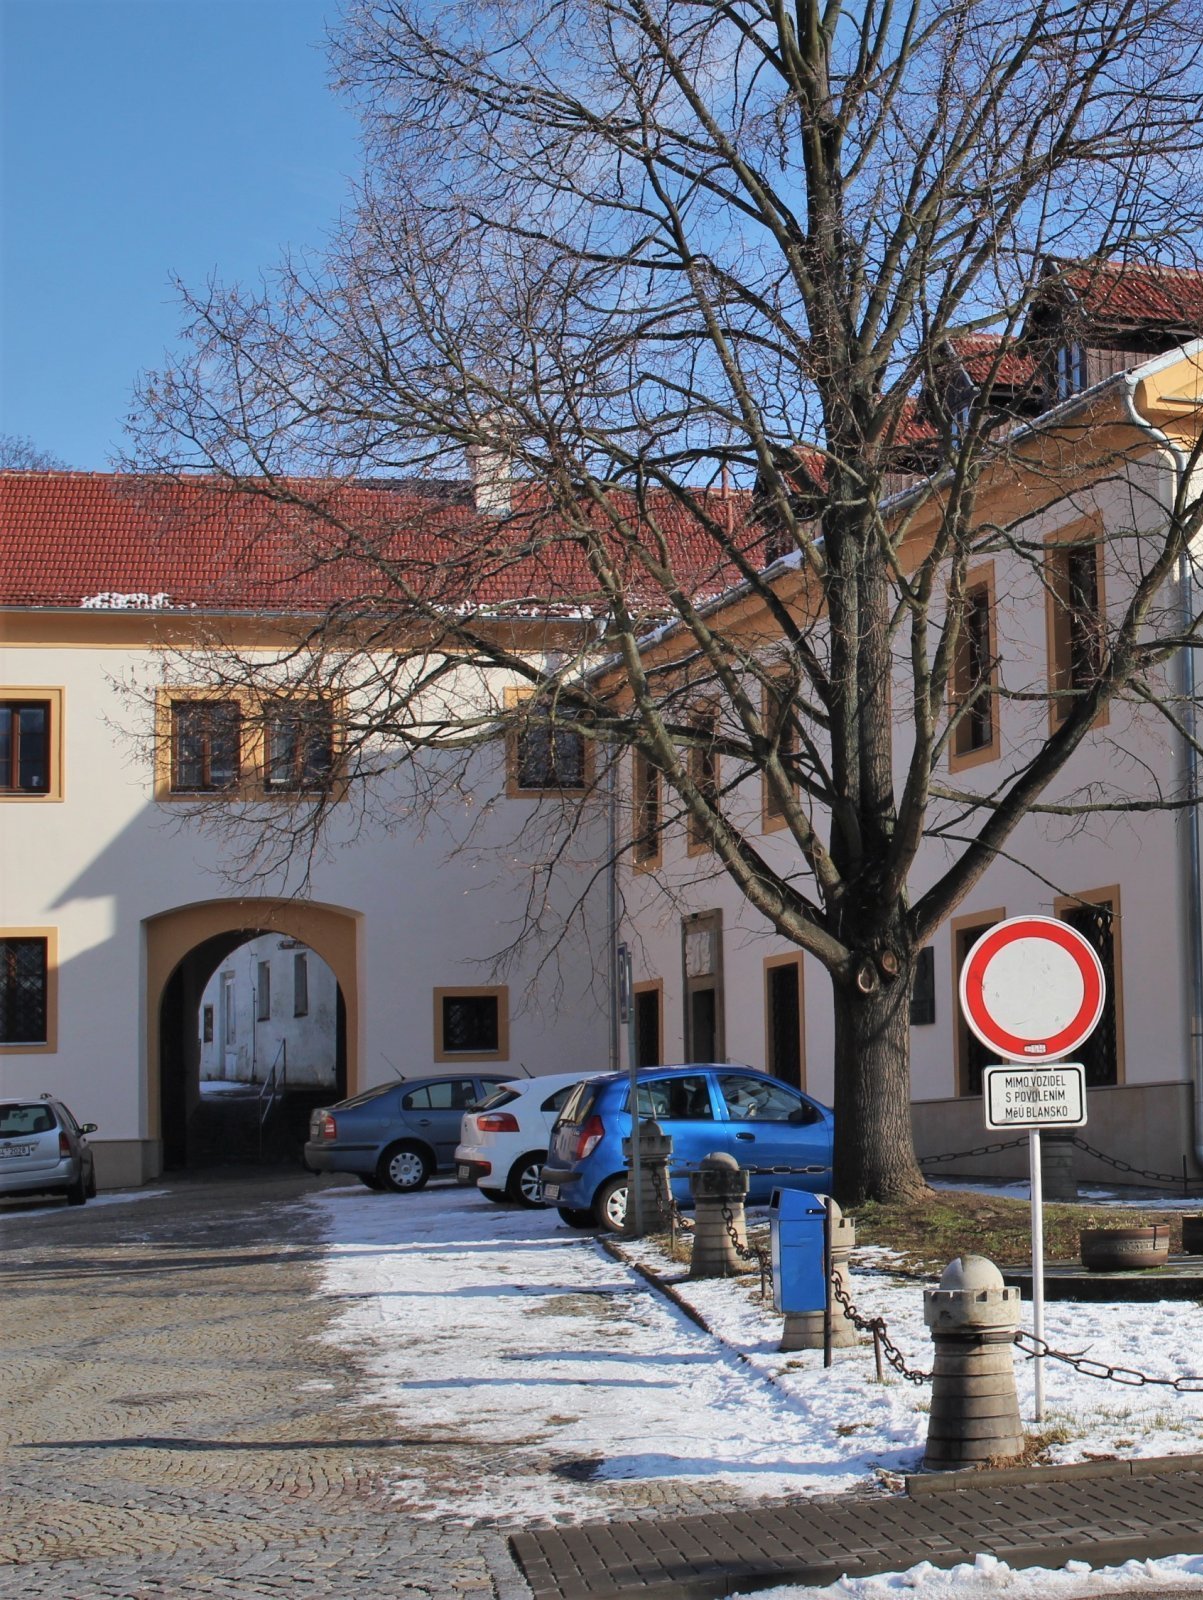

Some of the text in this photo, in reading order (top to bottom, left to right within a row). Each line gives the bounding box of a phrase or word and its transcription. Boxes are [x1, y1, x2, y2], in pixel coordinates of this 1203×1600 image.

[1005, 1075, 1066, 1088] MIMO VOZIDEL
[1005, 1087, 1065, 1103] S POVOLENÍM
[1005, 1104, 1068, 1118] MěÚ BLANSKO
